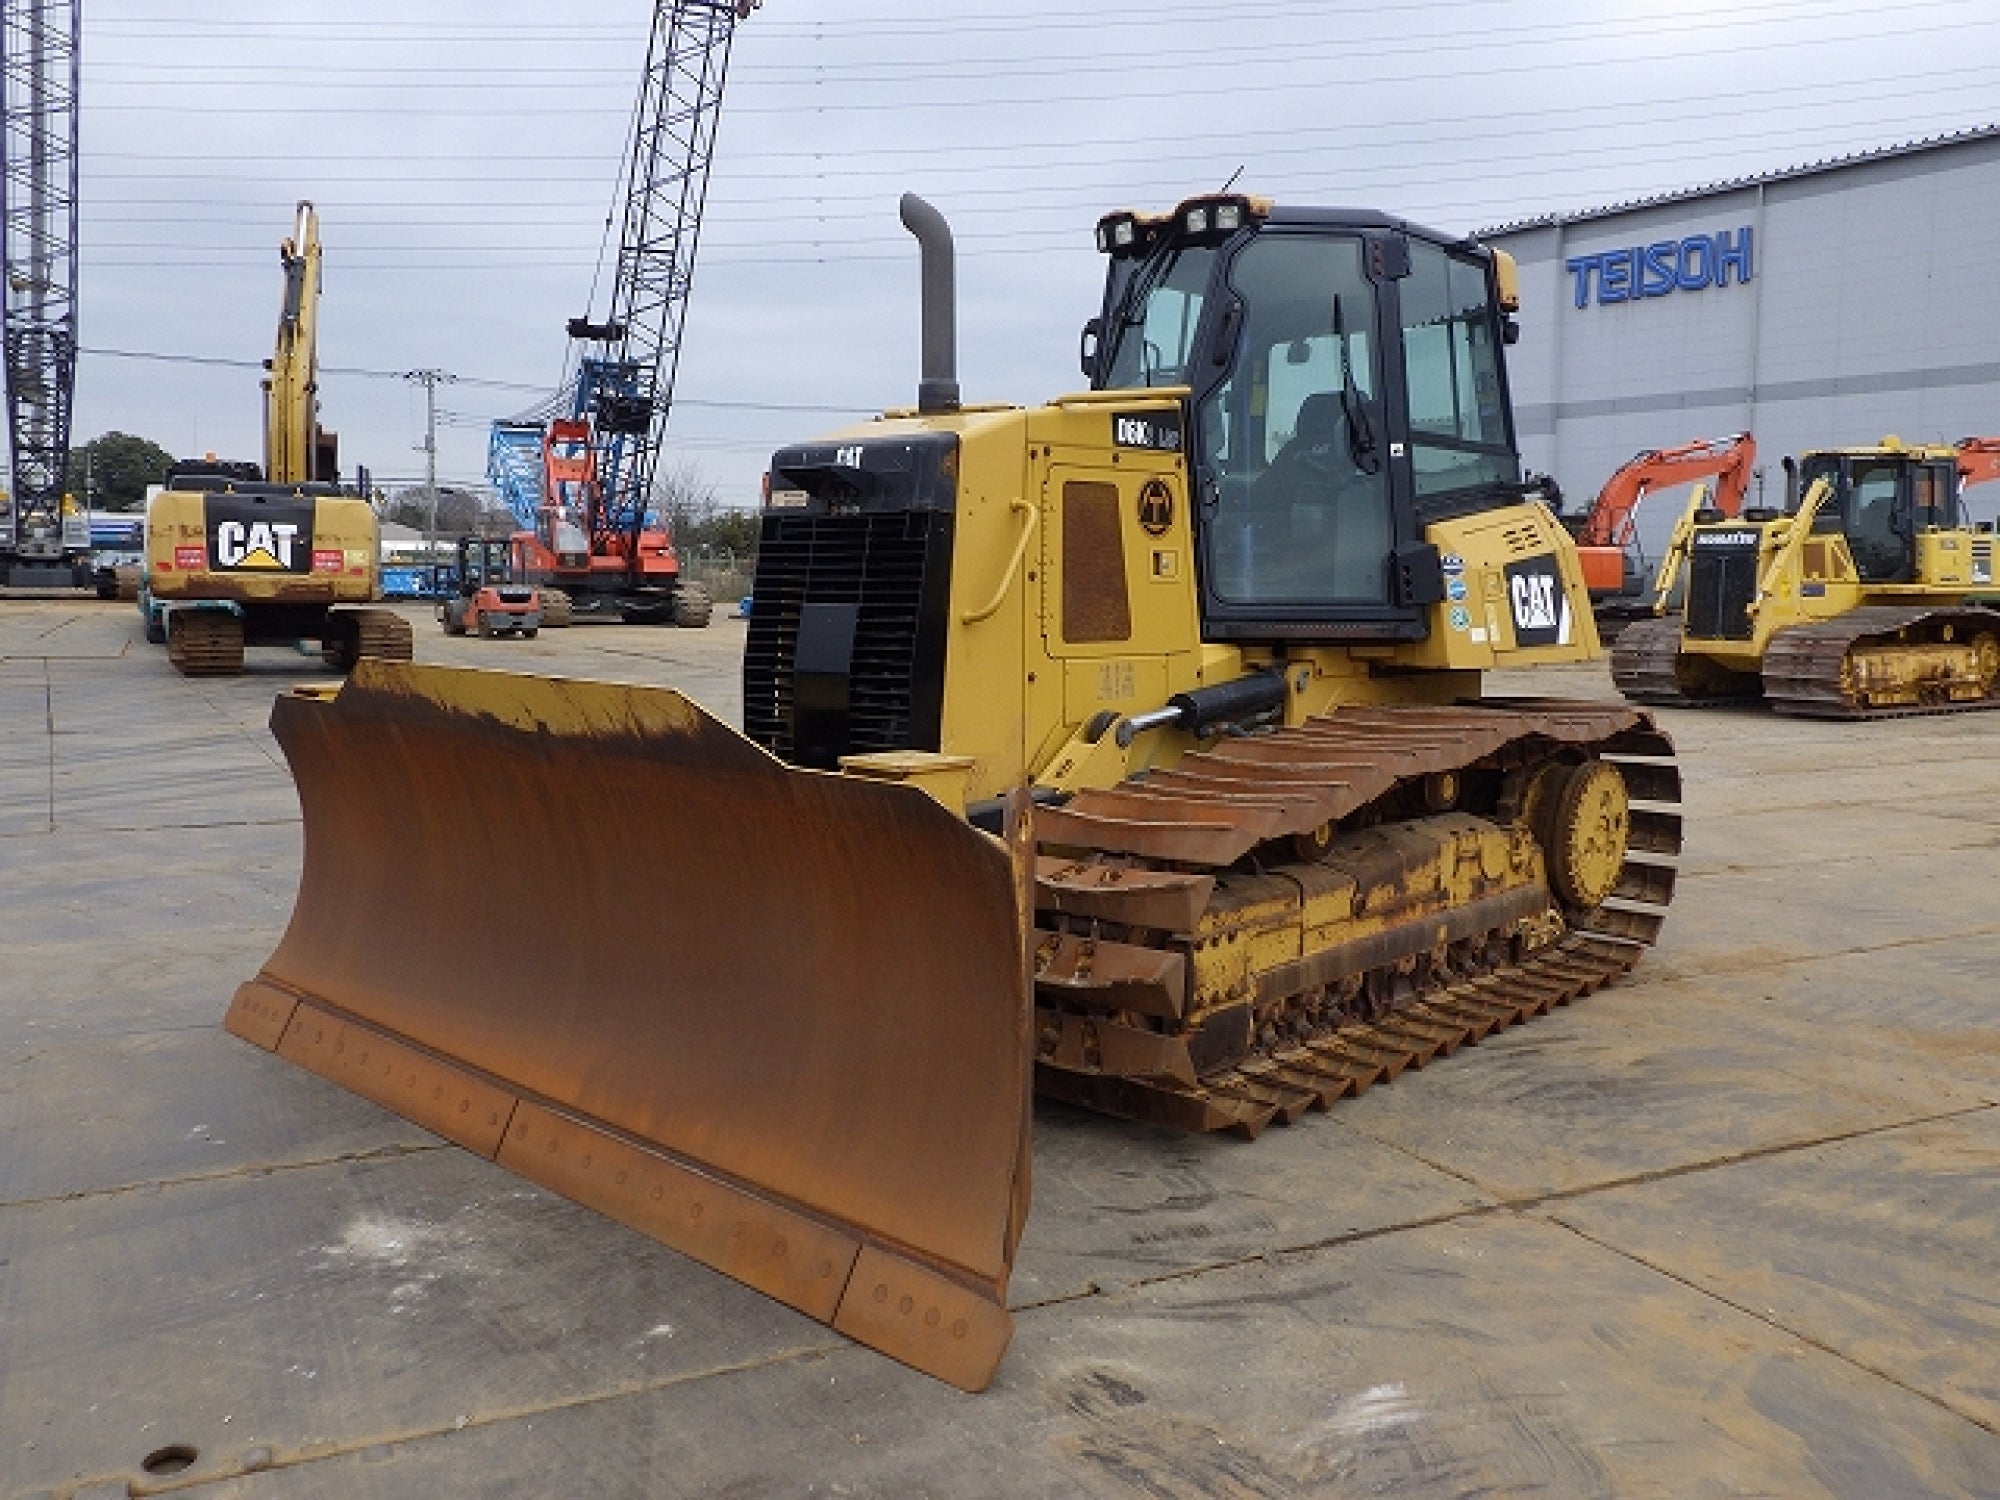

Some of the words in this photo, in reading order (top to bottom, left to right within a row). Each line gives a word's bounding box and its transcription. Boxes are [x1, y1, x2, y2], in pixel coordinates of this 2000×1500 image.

[1565, 225, 1754, 310] TEISOH
[218, 520, 298, 570] CAT
[1511, 572, 1557, 628] CAT
